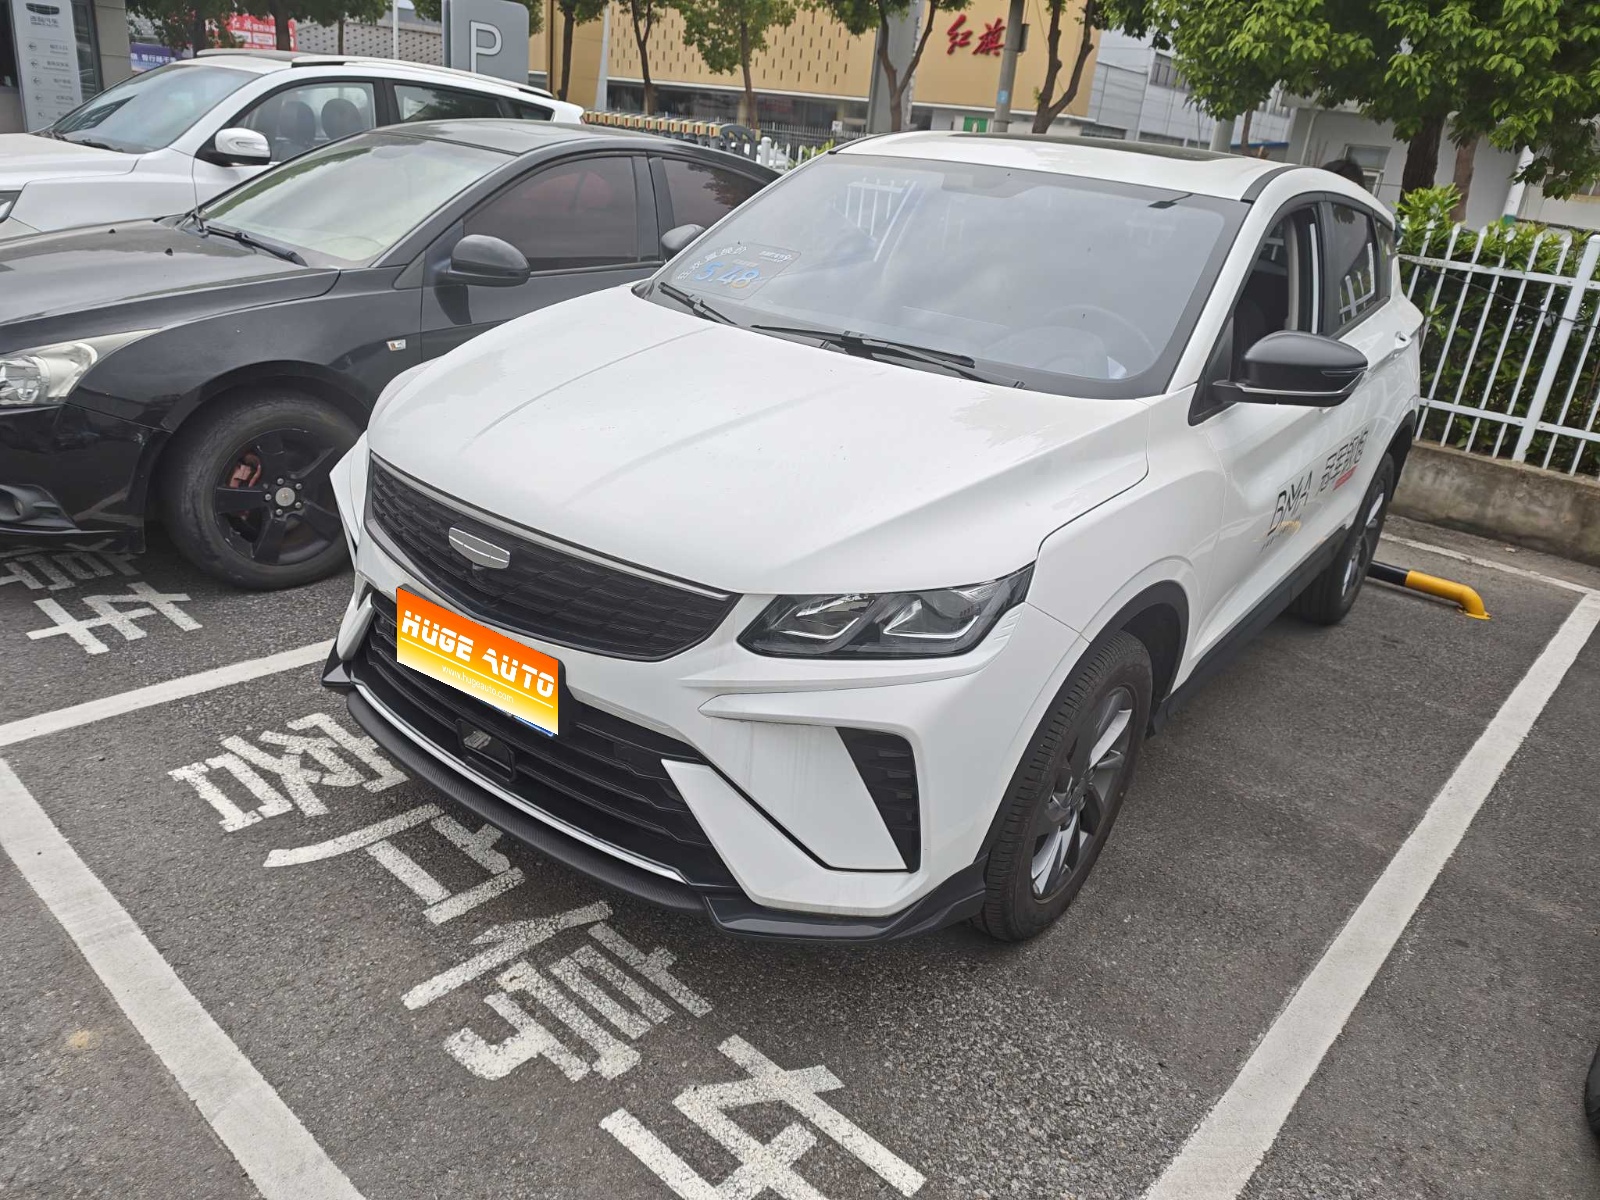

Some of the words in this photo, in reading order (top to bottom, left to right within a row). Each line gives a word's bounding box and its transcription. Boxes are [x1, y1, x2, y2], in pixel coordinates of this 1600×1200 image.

[469, 19, 502, 73] P
[946, 13, 1007, 57] 红旗
[167, 712, 927, 1200] 客户停车
